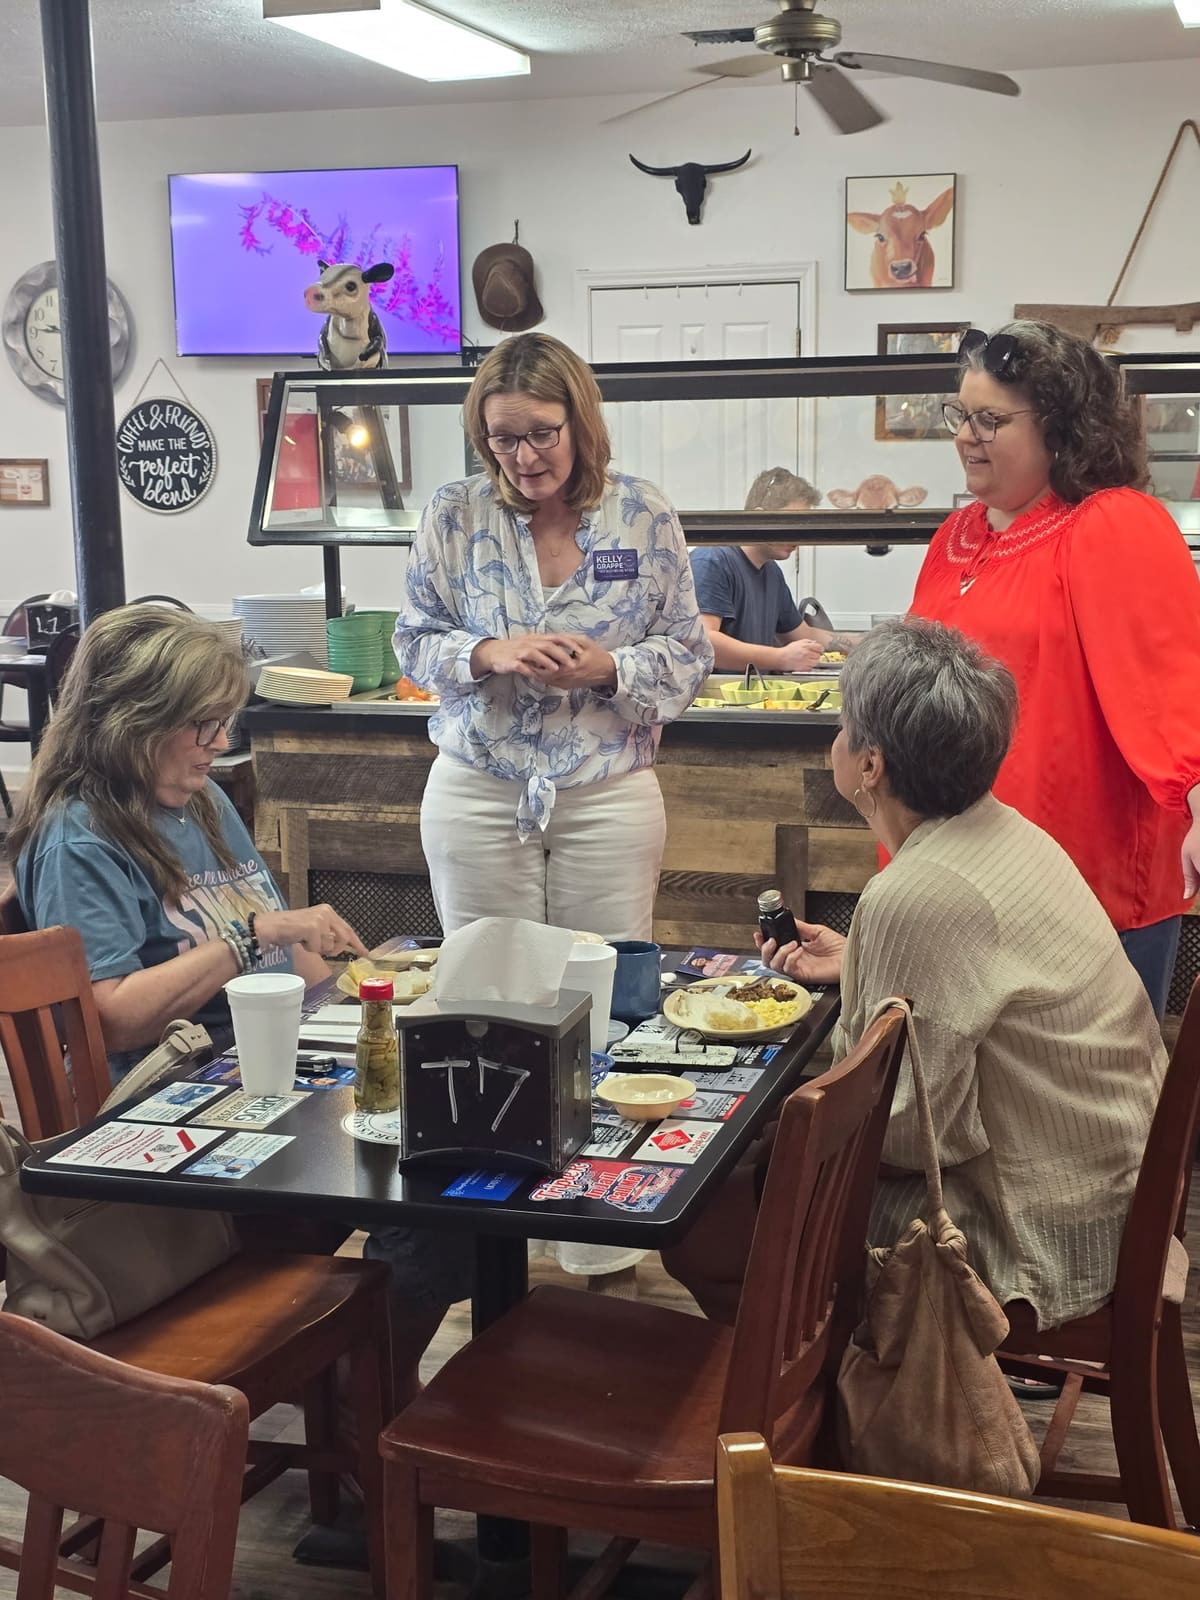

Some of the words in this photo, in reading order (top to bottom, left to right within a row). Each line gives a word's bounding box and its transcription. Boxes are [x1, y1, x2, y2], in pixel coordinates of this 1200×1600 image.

[117, 410, 148, 453] COFFEE
[149, 404, 167, 430] &
[165, 404, 210, 449] FRIENDS
[138, 439, 165, 452] MAKE
[167, 438, 187, 450] THE
[128, 453, 201, 490] perfect
[143, 477, 197, 505] blend
[596, 555, 623, 563] KELLY
[232, 1095, 285, 1121] DRUG
